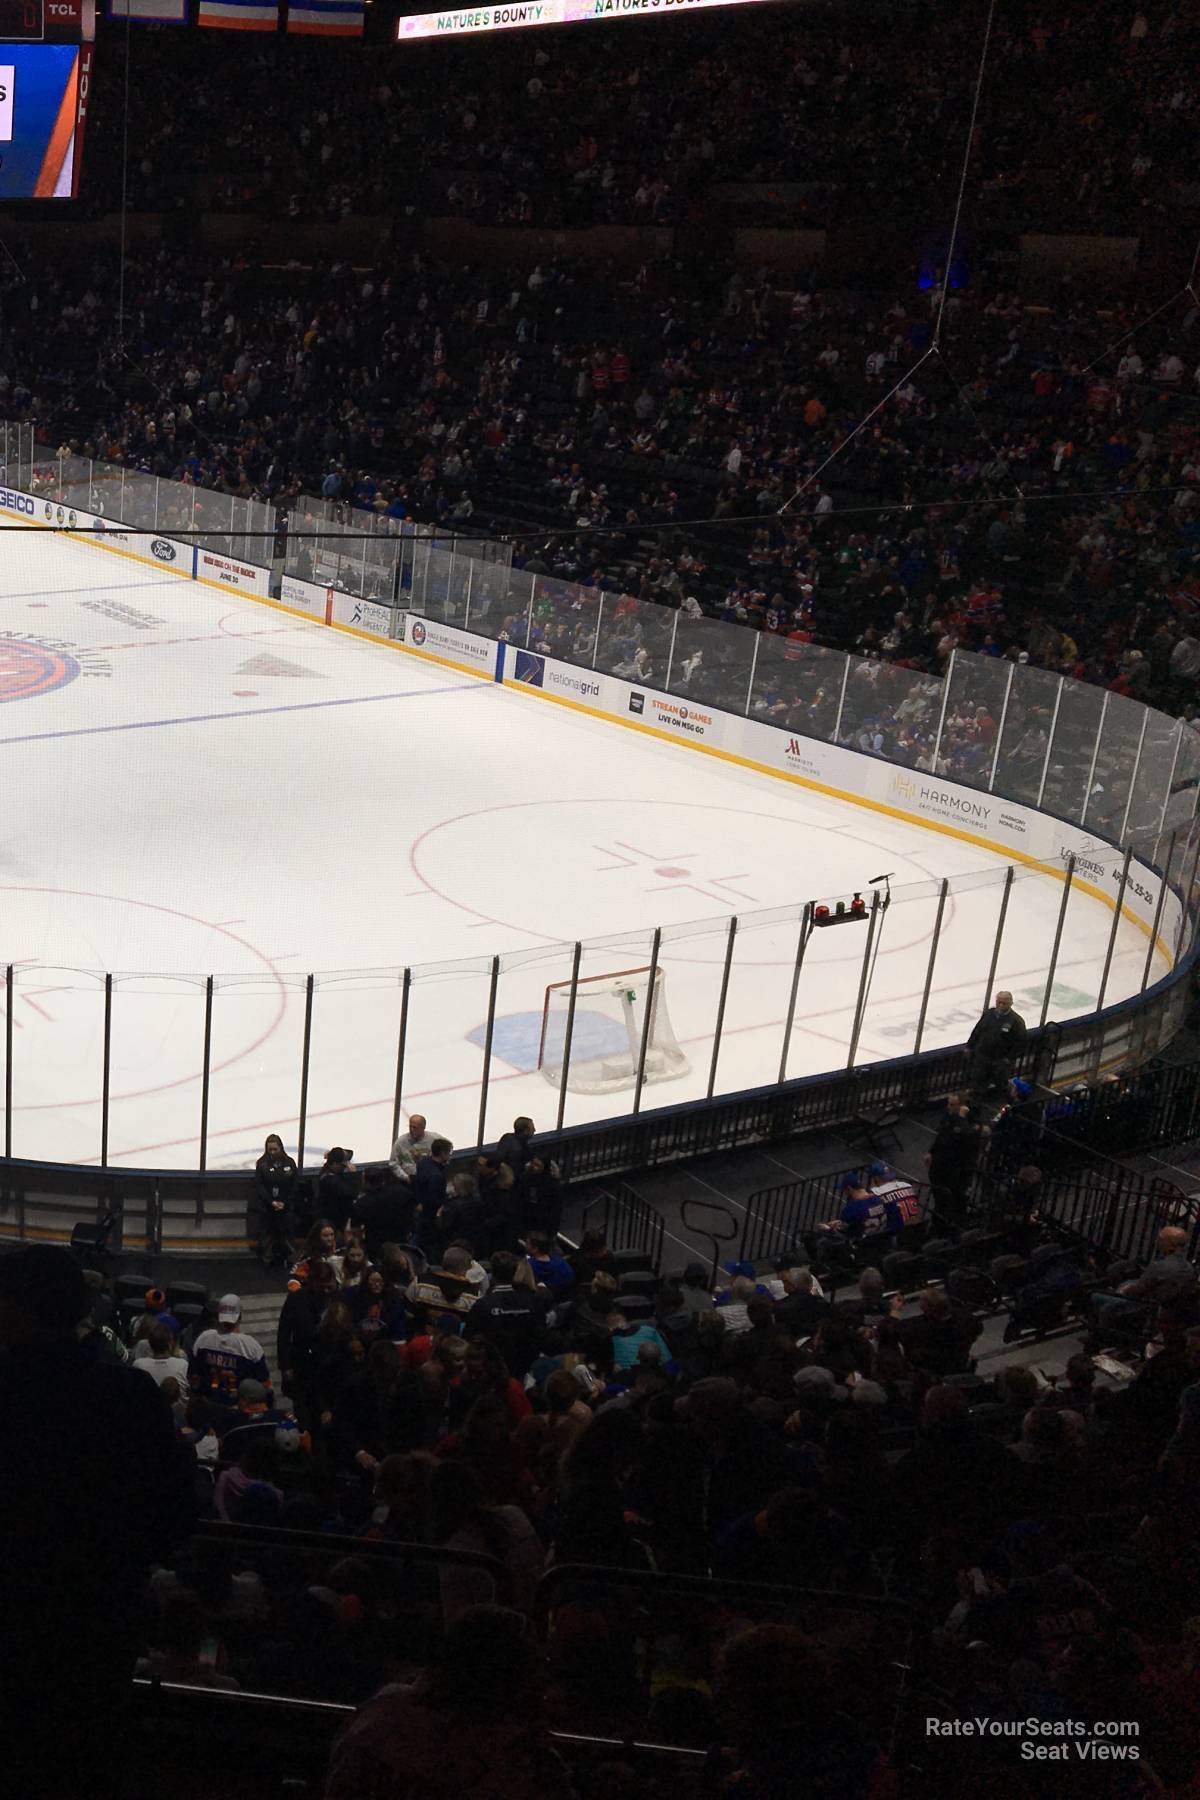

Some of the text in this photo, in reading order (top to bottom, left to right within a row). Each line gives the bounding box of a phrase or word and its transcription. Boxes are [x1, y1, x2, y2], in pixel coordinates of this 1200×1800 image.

[49, 5, 77, 16] TCL
[493, 6, 543, 24] BOUNTY
[77, 52, 91, 123] TCL
[550, 671, 600, 696] nationalgrid
[658, 713, 705, 735] LIVE ON MSG GO
[689, 711, 713, 725] GAMES
[920, 786, 991, 819] HARMONY
